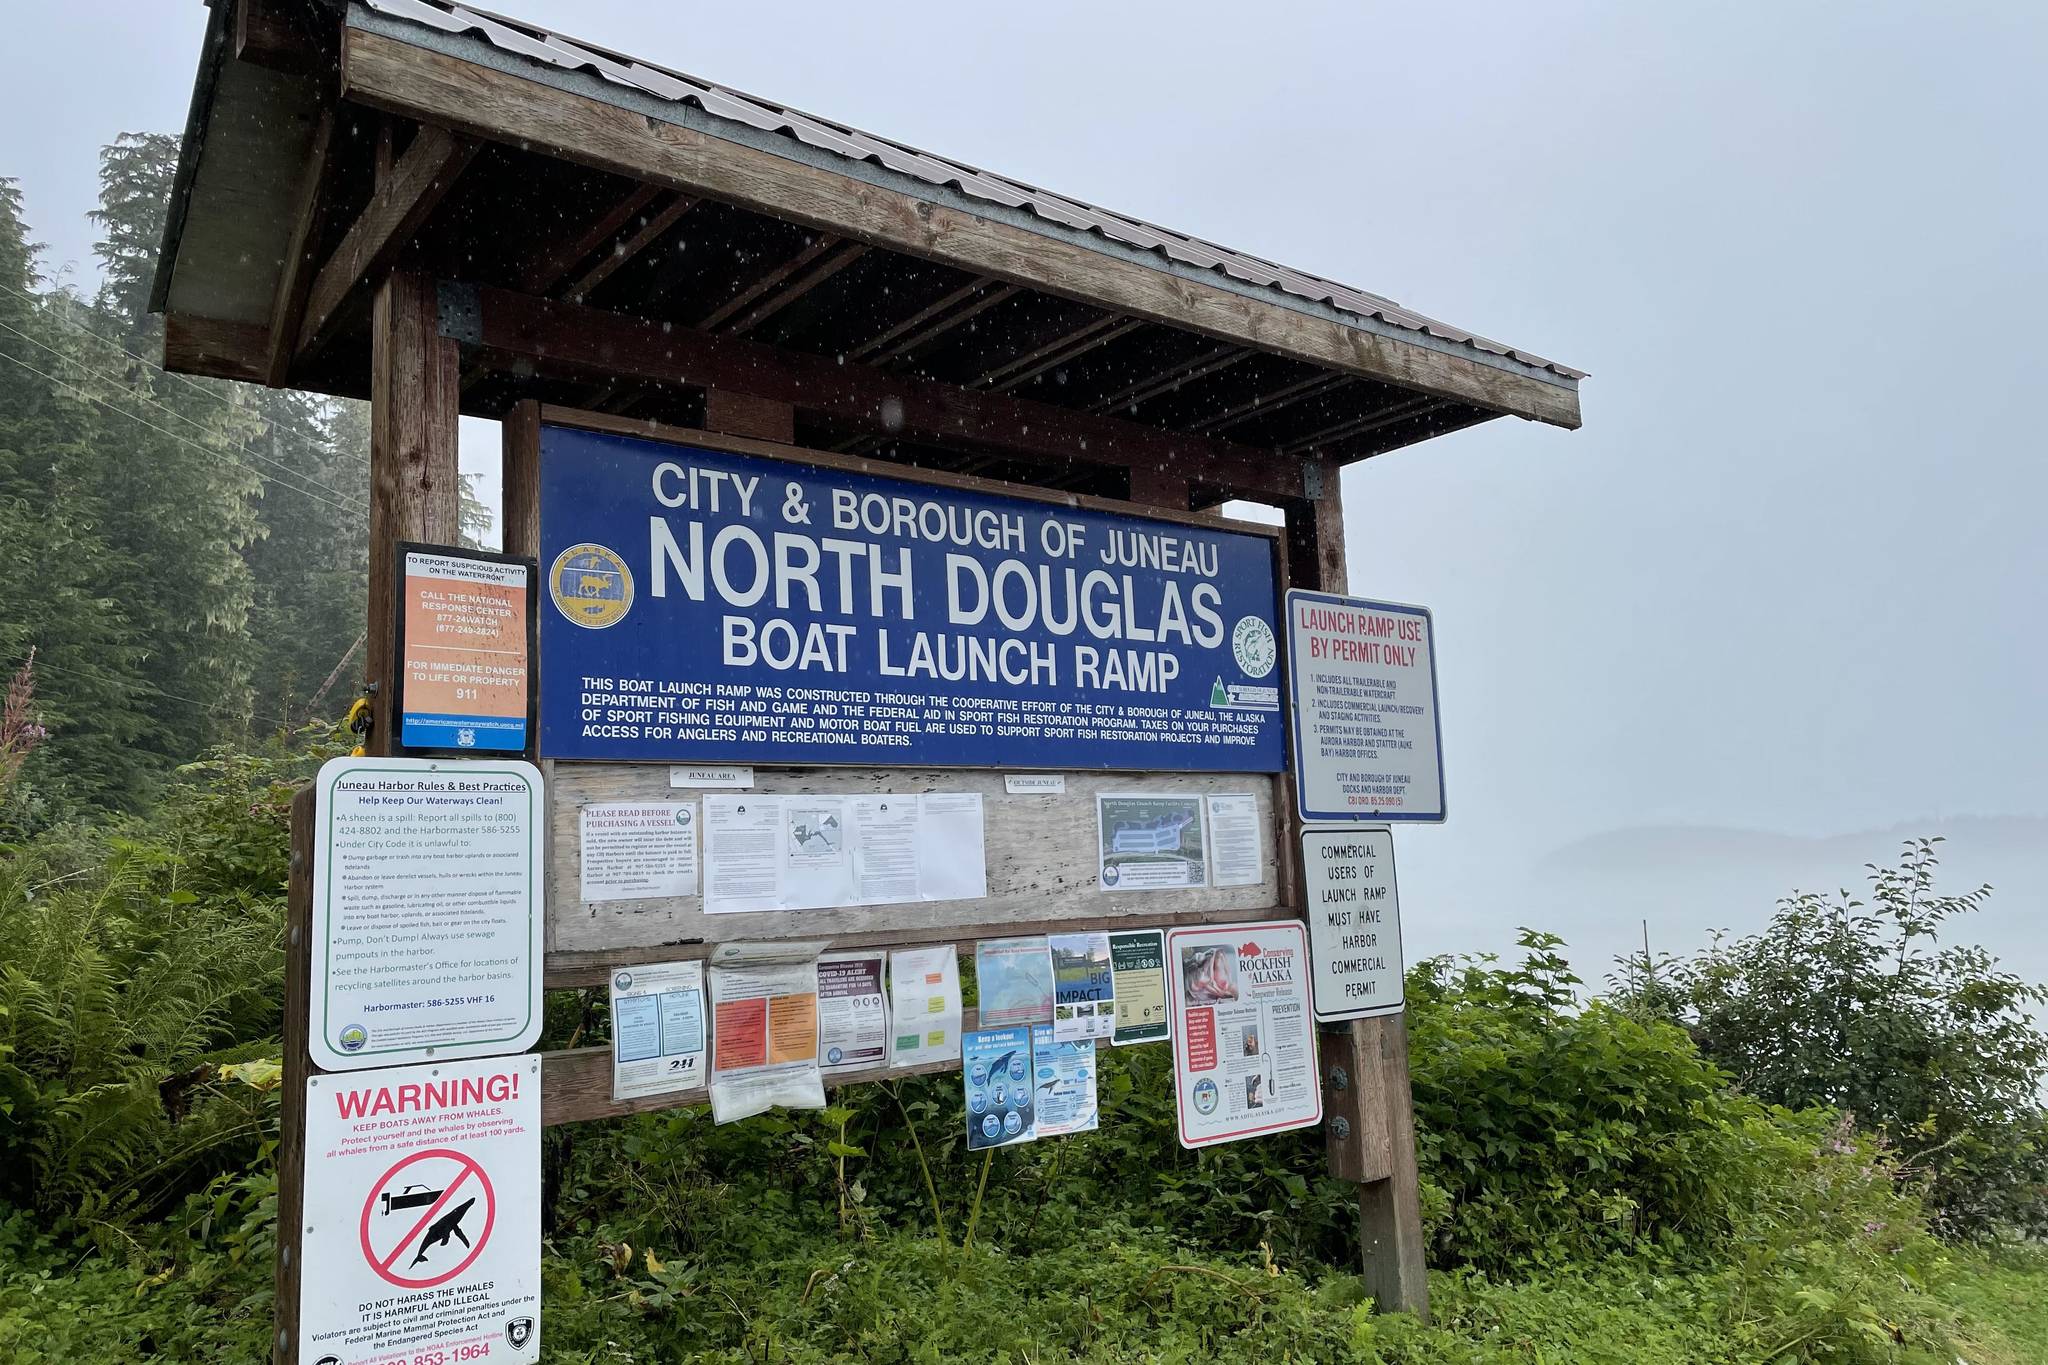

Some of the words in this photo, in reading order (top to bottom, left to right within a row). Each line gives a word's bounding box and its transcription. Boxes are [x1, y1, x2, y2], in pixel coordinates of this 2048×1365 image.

[652, 462, 759, 516] CITY
[782, 482, 812, 525] &
[832, 488, 1026, 552] BOROUGH
[1040, 519, 1086, 559] OF
[1100, 529, 1219, 577] JUNEAU
[451, 561, 493, 572] SUSPICIOUS
[495, 567, 526, 576] ACTIVITY
[457, 571, 504, 581] WATERFRONT
[650, 516, 914, 620] NORTH
[946, 553, 1224, 649] DOUGLAS
[420, 591, 445, 600] CALL
[448, 593, 466, 601] THE
[468, 596, 512, 607] NATIONAL
[422, 602, 473, 612] RESPONSE
[475, 608, 512, 617] CENTER
[437, 614, 498, 626] 877-24WATCH
[1301, 608, 1354, 633] LAUNCH
[1358, 614, 1394, 638] RAMP
[1398, 619, 1421, 641] USE
[1236, 618, 1255, 638] SPORT
[1258, 620, 1272, 642] FISH
[722, 615, 857, 673] BOAT
[879, 629, 1056, 686] LAUNCH
[1075, 645, 1179, 693] RAMP
[1234, 643, 1274, 675] RESTORATION
[1311, 636, 1328, 658] BY
[1333, 639, 1379, 663] PERMIT
[1384, 644, 1414, 666] ONLY
[407, 660, 427, 669] FOR
[431, 662, 482, 673] IMMEDIATE
[485, 667, 526, 676] DANGER
[469, 676, 519, 687] PROPERTY
[456, 689, 477, 699] 911
[582, 677, 613, 690] THIS
[619, 679, 654, 692] BOAT
[659, 680, 712, 694] LAUNCH
[716, 684, 750, 696] RAMP
[755, 686, 781, 698] WAS
[786, 687, 870, 702] CONSTRUCTED
[874, 692, 924, 705] THROUGH
[928, 696, 948, 706] THE
[952, 696, 1018, 710] COOPERATIVE
[1022, 701, 1056, 712] EFFORT
[1060, 703, 1072, 712] OF
[1075, 704, 1092, 713] THE
[1095, 705, 1114, 714] CITY
[1118, 706, 1124, 715] &
[1127, 707, 1167, 717] BOROUGH
[1170, 709, 1181, 718] OF
[1184, 710, 1216, 721] JUNEAU,
[1218, 712, 1234, 721] THE
[1236, 713, 1265, 722] ALASKA
[582, 724, 638, 738] ACCESS
[645, 726, 671, 738] FOR
[677, 728, 736, 740] ANGLERS
[741, 730, 766, 741] AND
[771, 730, 856, 744] RECREATIONAL
[861, 734, 912, 745] BOATERS.
[337, 780, 375, 790] Juneau
[378, 780, 414, 790] Harbor
[418, 781, 444, 790] Rules
[448, 782, 455, 790] &
[459, 782, 480, 790] Best
[483, 782, 526, 791] Practices
[359, 796, 379, 805] Help
[382, 796, 404, 805] Keep
[426, 797, 473, 806] Waterways
[396, 813, 415, 822] spill:
[418, 814, 446, 822] Report
[461, 813, 481, 822] spills
[495, 813, 516, 822] (800)
[420, 825, 479, 833] Harbormaster
[1322, 845, 1376, 858] COMMERCIAL
[1328, 866, 1356, 879] USERS
[1364, 865, 1374, 878] OF
[1322, 888, 1356, 902] LAUNCH
[1364, 886, 1386, 900] RAMP
[1328, 912, 1350, 926] MUST
[1359, 910, 1380, 923] HAVE
[1342, 934, 1376, 949] HARBOR
[1240, 957, 1290, 972] ROCKFISH
[1332, 957, 1385, 974] COMMERCIAL
[1090, 972, 1110, 984] BIG
[1252, 969, 1292, 983] ALASKA
[1056, 988, 1101, 1004] IMPACT
[1346, 981, 1375, 997] PERMIT
[364, 1002, 424, 1012] Harbormaster:
[427, 997, 464, 1007] 586-5255
[1272, 1003, 1300, 1014] PREVENTION
[336, 1074, 519, 1120] WARNING!
[353, 1123, 376, 1131] KEEP
[380, 1119, 408, 1128] BOATS
[412, 1115, 436, 1124] AWAY
[439, 1112, 463, 1121] FROM
[466, 1107, 503, 1118] WHALES.
[342, 1135, 370, 1144] Protect
[373, 1131, 404, 1142] yourself
[477, 1118, 512, 1127] observing
[358, 1302, 372, 1312] DO
[375, 1298, 394, 1308] NOT
[397, 1291, 434, 1304] HARASS
[436, 1288, 454, 1297] THE
[457, 1281, 493, 1294] WHALES
[362, 1313, 370, 1322] IT
[373, 1311, 381, 1320] IS
[384, 1303, 428, 1318] HARMFUL
[431, 1299, 450, 1309] AND
[453, 1292, 490, 1305] ILLEGAL
